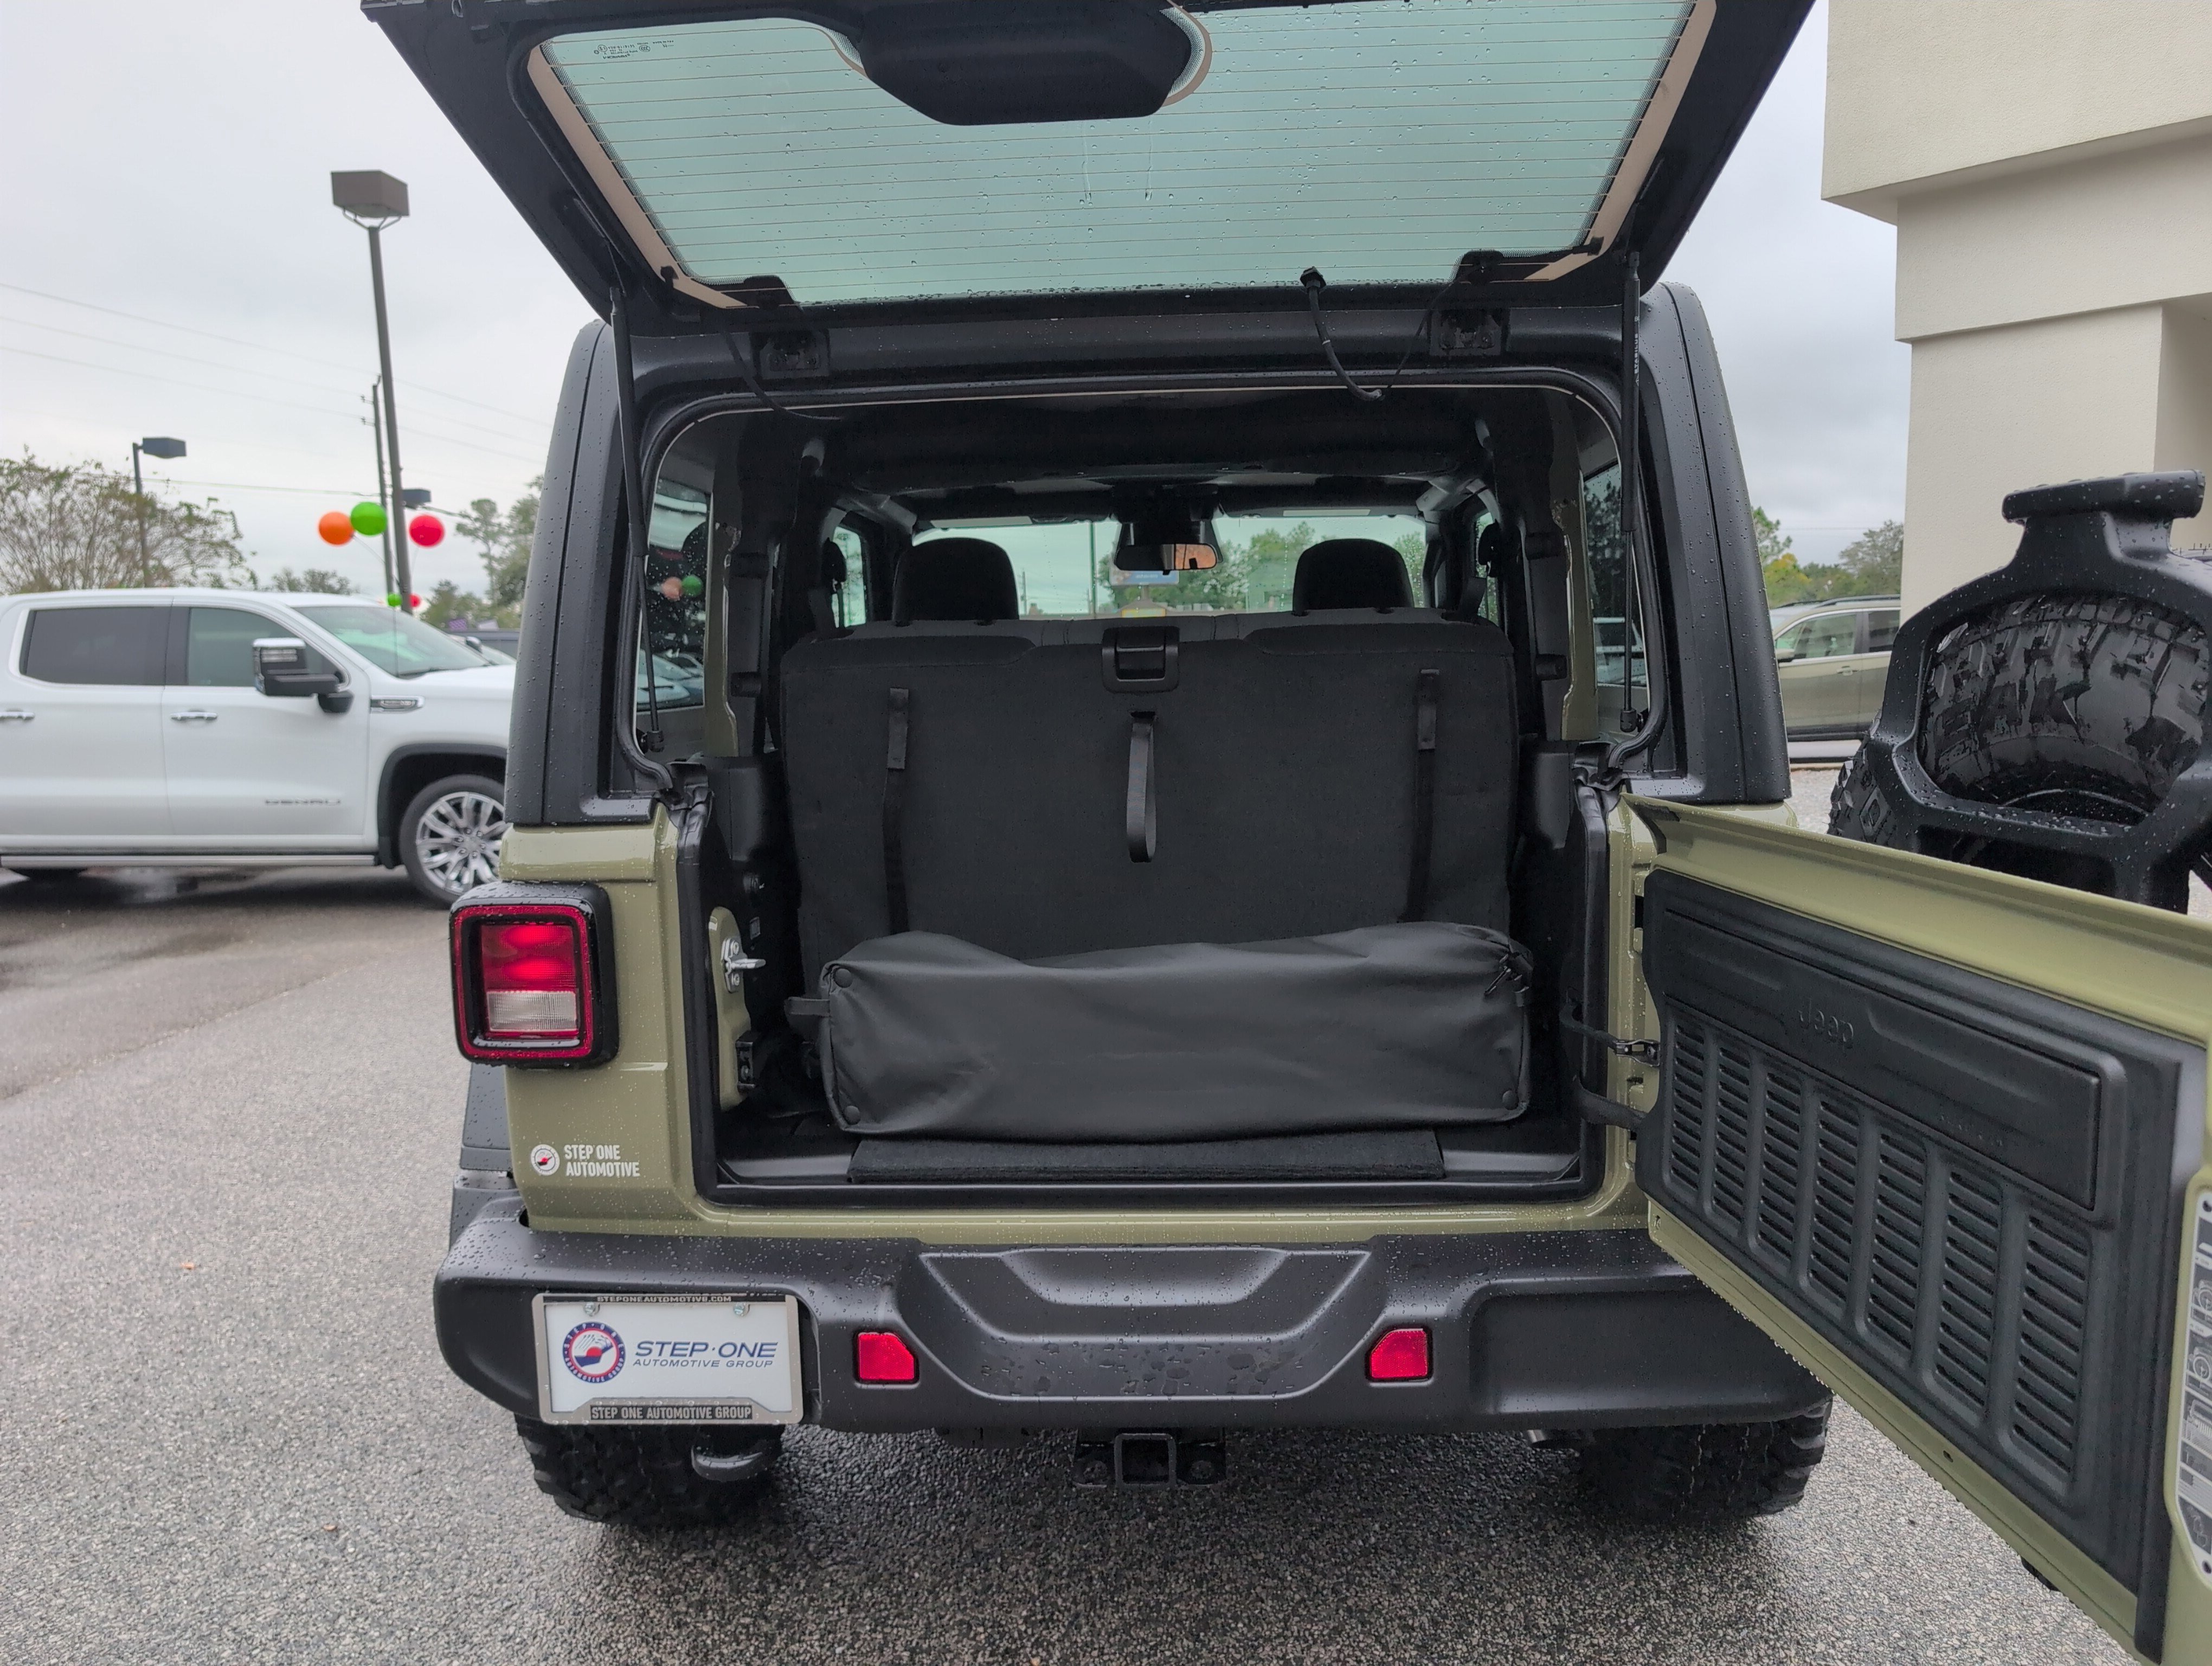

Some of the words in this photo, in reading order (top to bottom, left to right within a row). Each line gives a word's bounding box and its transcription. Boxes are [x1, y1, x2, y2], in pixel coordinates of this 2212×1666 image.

[564, 1144, 594, 1160] STEP
[596, 1144, 621, 1160] ONE
[566, 1161, 641, 1177] AUTOMOTIVE
[633, 1359, 720, 1368] AUTOMOTIVE
[726, 1360, 773, 1368] GROUP
[591, 1407, 618, 1419] STEP
[621, 1407, 644, 1419] ONE
[647, 1407, 713, 1419] AUTOMOTIVE
[715, 1406, 751, 1419] GROUP
